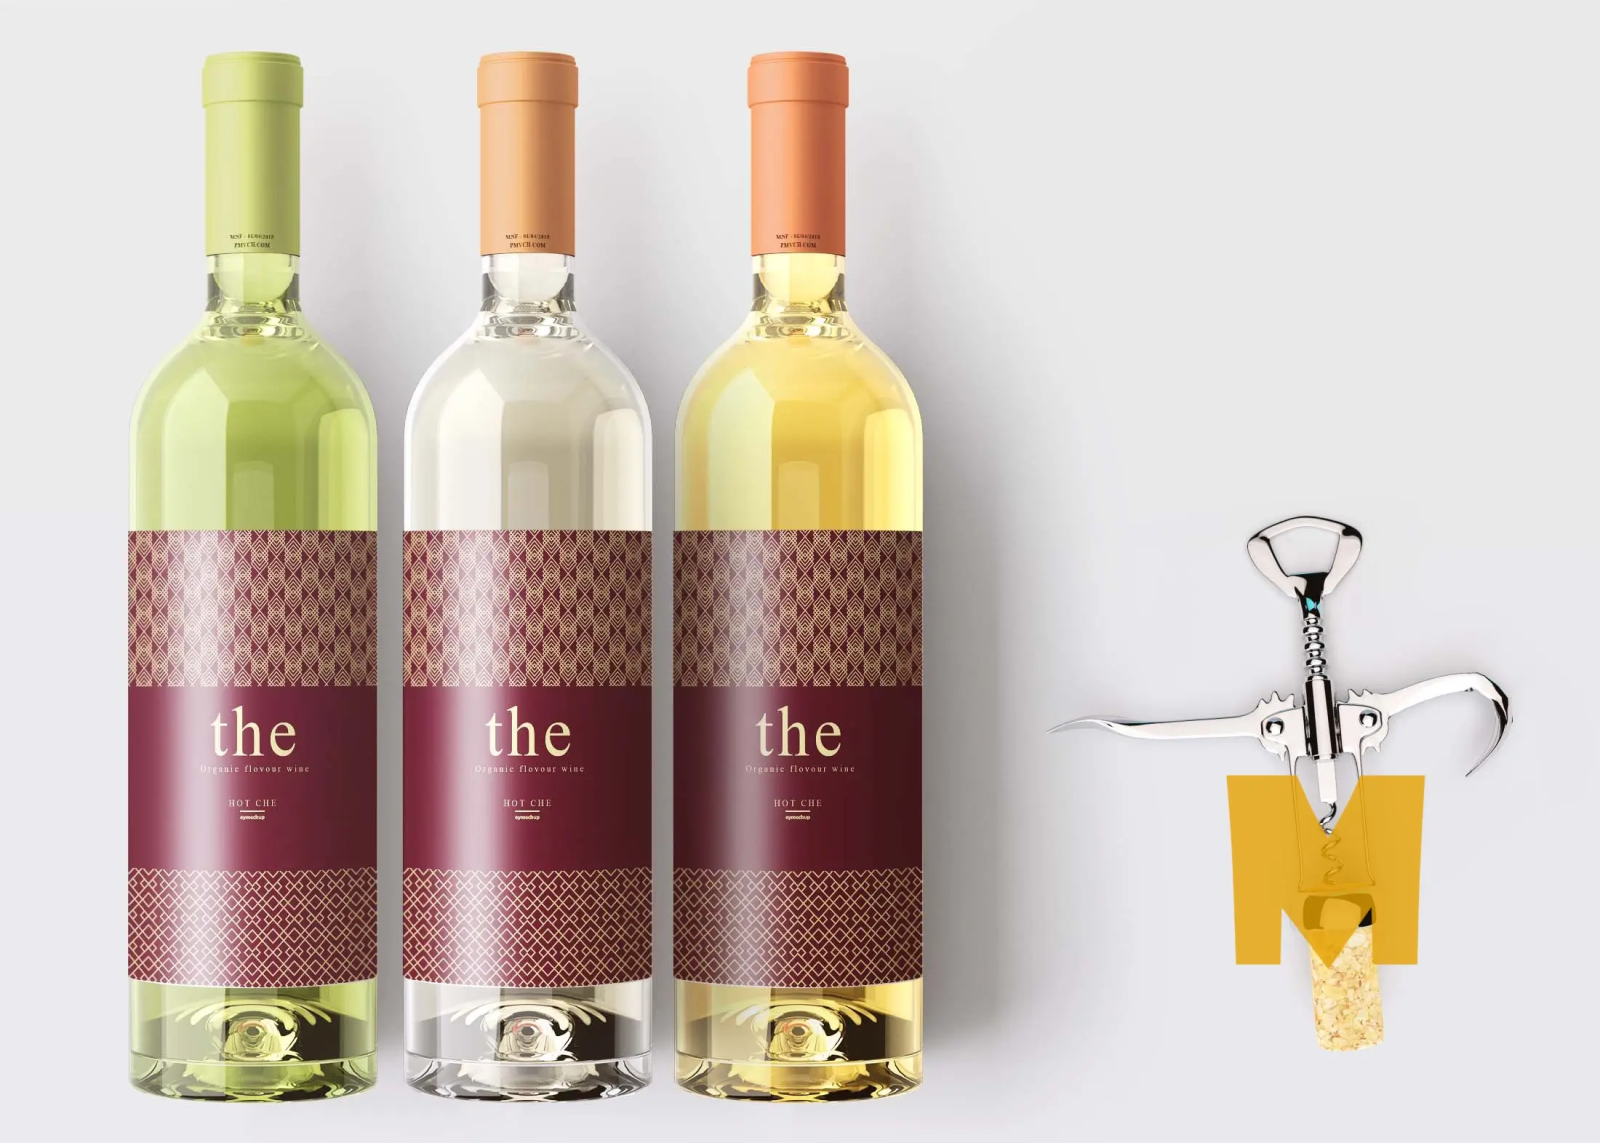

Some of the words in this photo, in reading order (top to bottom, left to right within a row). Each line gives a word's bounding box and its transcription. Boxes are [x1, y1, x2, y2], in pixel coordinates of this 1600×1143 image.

[210, 705, 296, 757] the
[485, 705, 571, 757] the
[756, 705, 842, 757] the
[200, 764, 240, 775] Organic
[287, 764, 310, 773] wine
[475, 764, 514, 775] Organic
[562, 764, 585, 773] wine
[746, 764, 785, 775] Organic
[832, 764, 855, 773] wine
[228, 799, 250, 807] HOT
[256, 799, 277, 807] CHE
[503, 799, 525, 807] HOT
[530, 799, 552, 807] CHE
[774, 799, 796, 807] HOT
[801, 799, 822, 807] CHE
